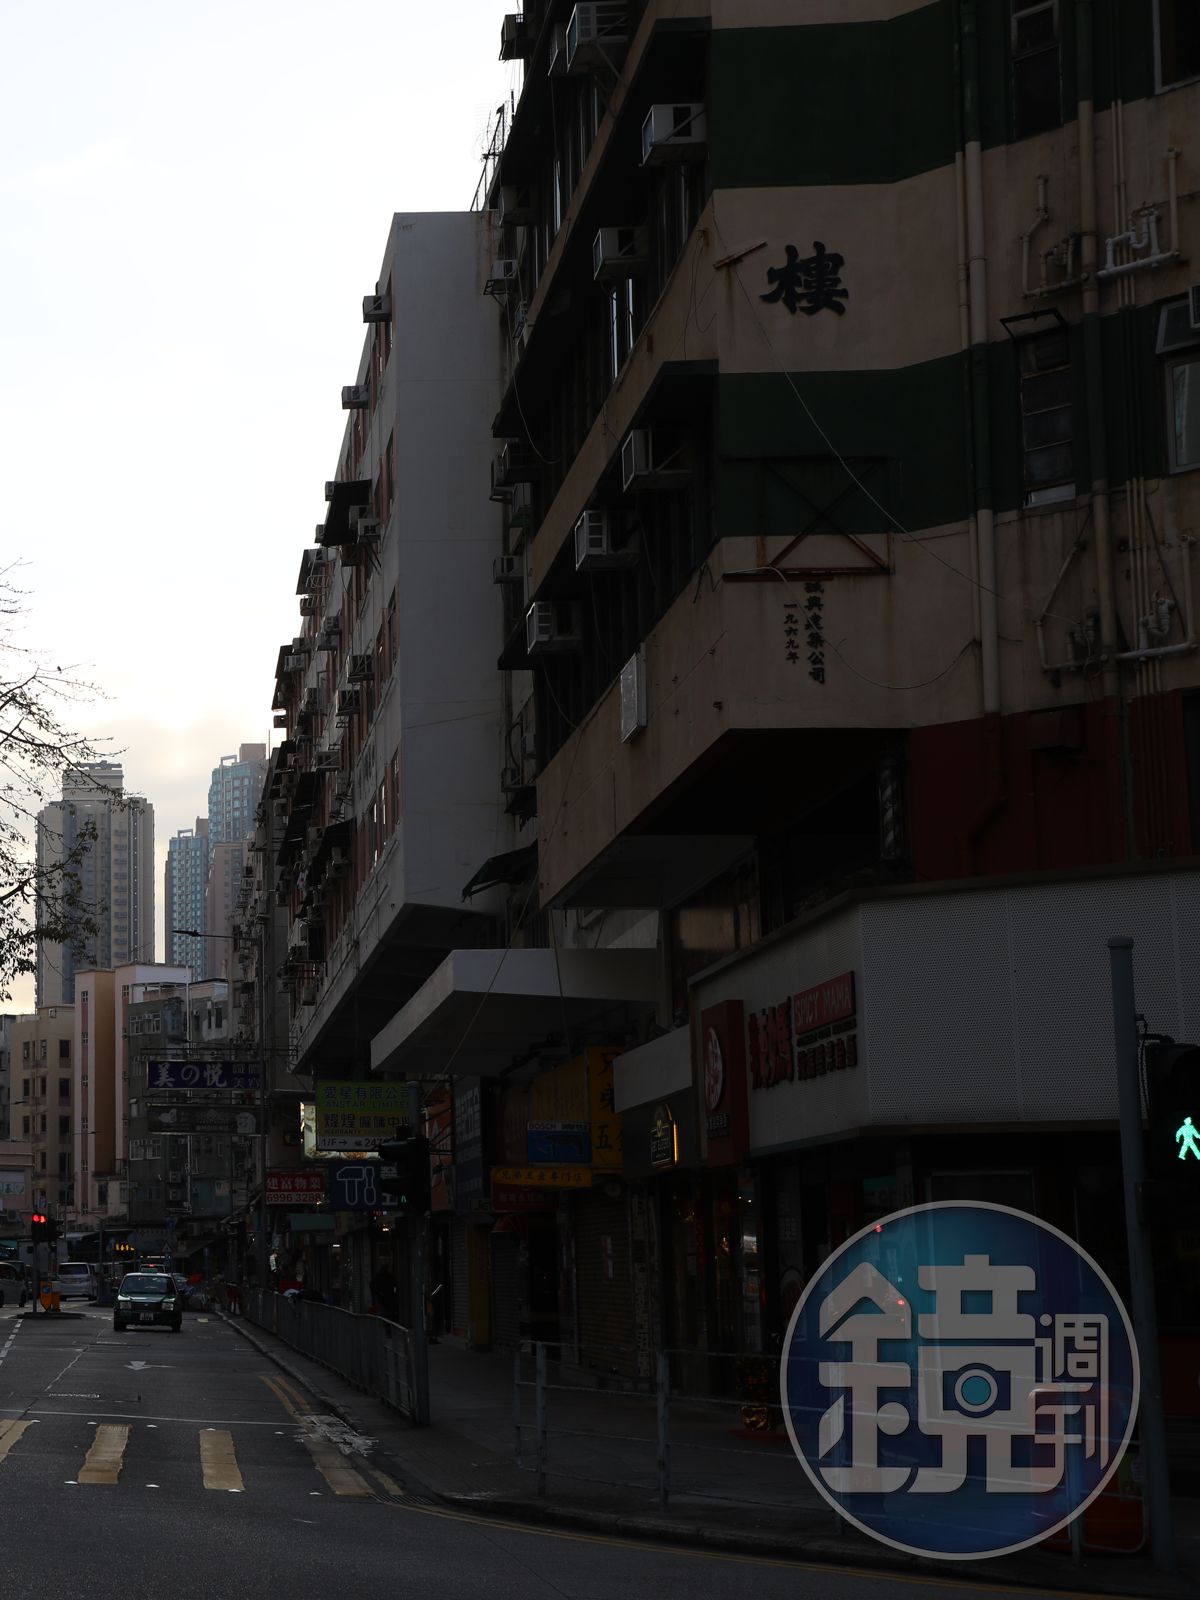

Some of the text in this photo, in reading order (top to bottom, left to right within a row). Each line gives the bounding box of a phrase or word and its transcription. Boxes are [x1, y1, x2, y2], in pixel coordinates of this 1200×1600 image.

[759, 241, 850, 316] 樓
[783, 603, 800, 664] 一九六九年
[795, 983, 852, 1027] SPICY MAMA
